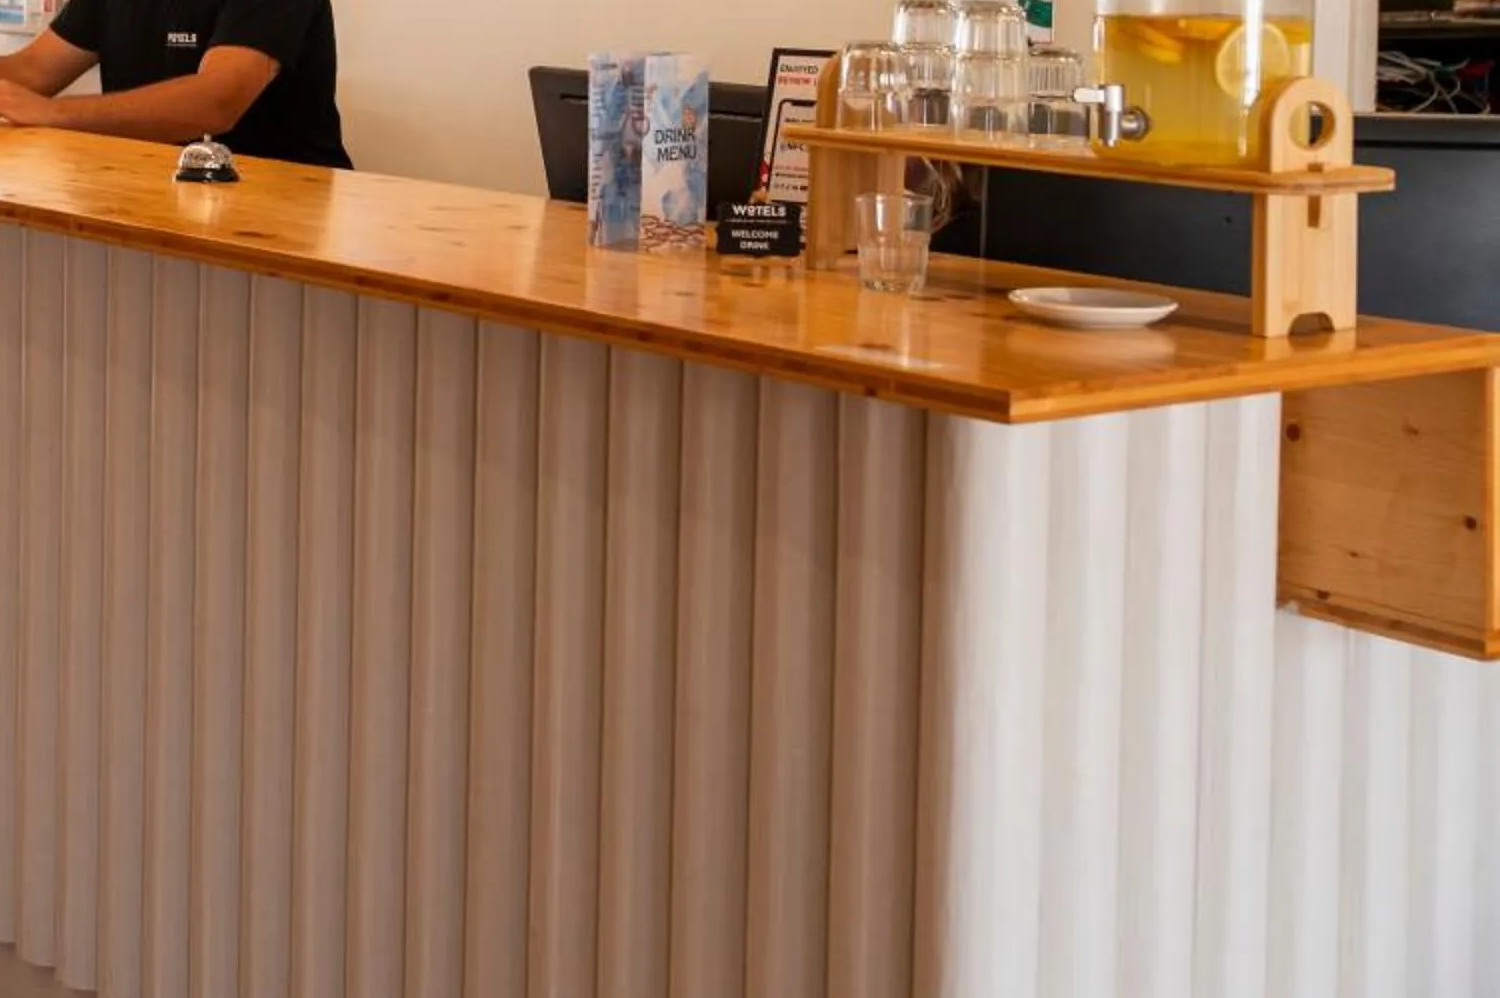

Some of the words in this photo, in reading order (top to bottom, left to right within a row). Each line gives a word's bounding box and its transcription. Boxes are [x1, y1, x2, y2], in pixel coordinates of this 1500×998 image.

[654, 127, 696, 145] DRINK
[656, 144, 697, 163] MENU
[731, 229, 780, 240] WELCOME
